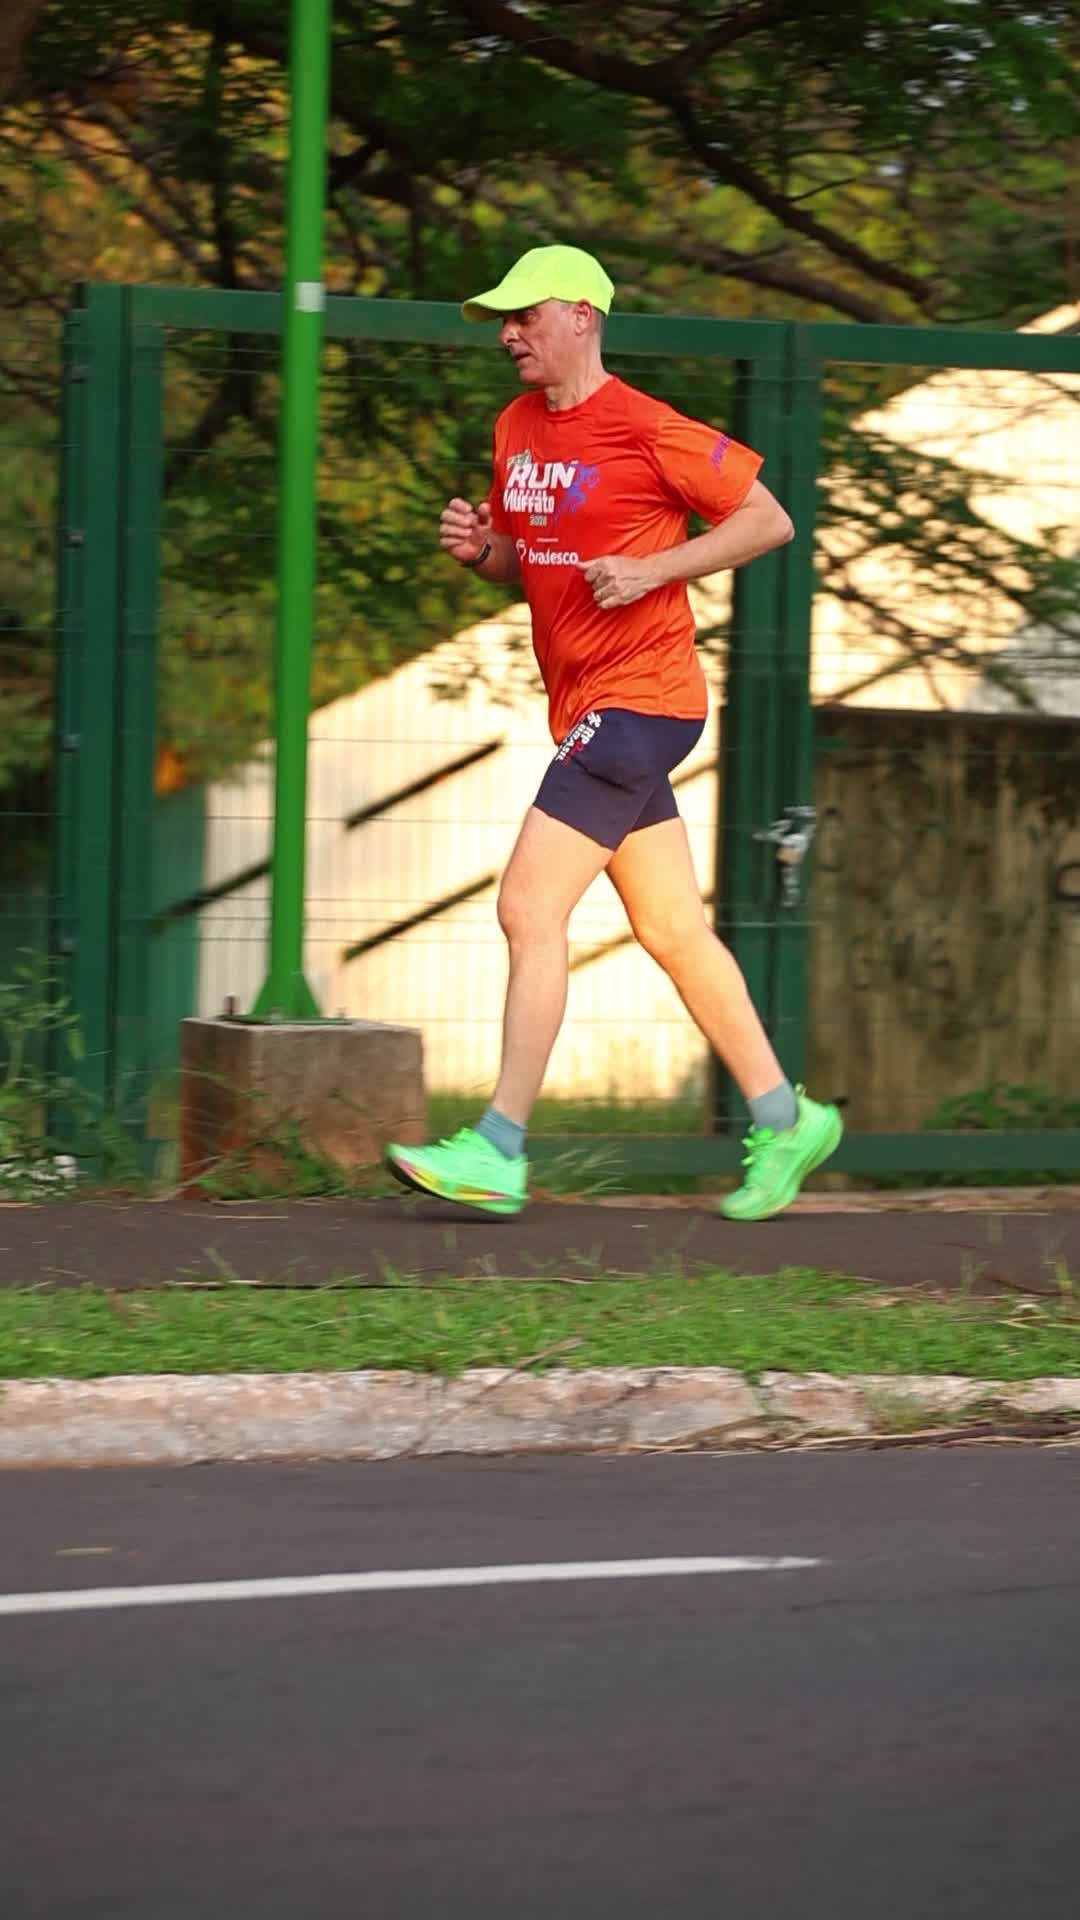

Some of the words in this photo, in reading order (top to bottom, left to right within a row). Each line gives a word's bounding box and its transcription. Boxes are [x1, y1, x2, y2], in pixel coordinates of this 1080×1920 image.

[506, 461, 577, 489] RUN
[528, 547, 579, 565] bradesco
[554, 723, 586, 761] BRASIL
